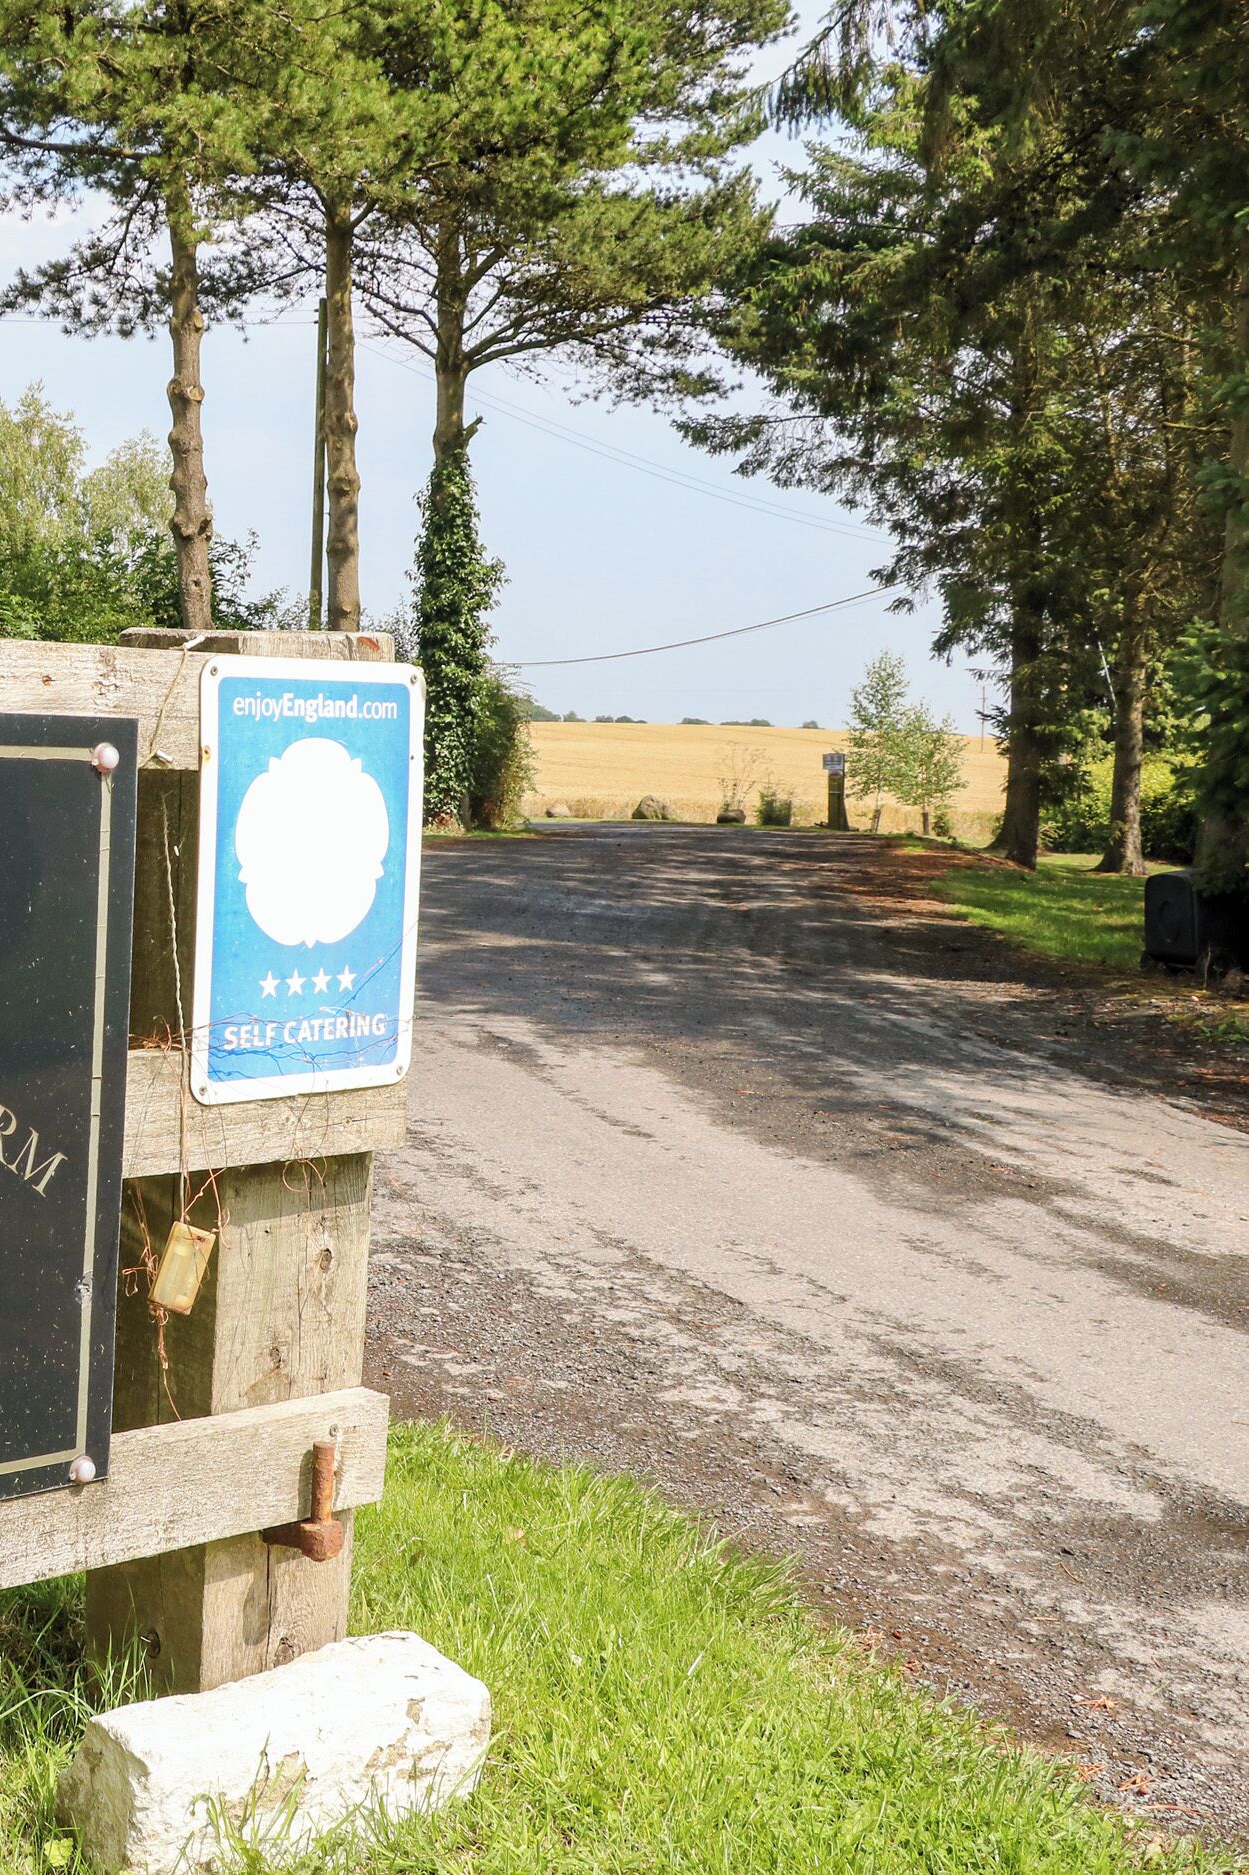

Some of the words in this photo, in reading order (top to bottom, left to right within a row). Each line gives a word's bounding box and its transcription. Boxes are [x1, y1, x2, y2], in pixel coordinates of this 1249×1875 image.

[232, 692, 398, 723] enjoyEngland.com
[223, 1024, 277, 1052] SELF
[283, 1013, 386, 1042] CATERING
